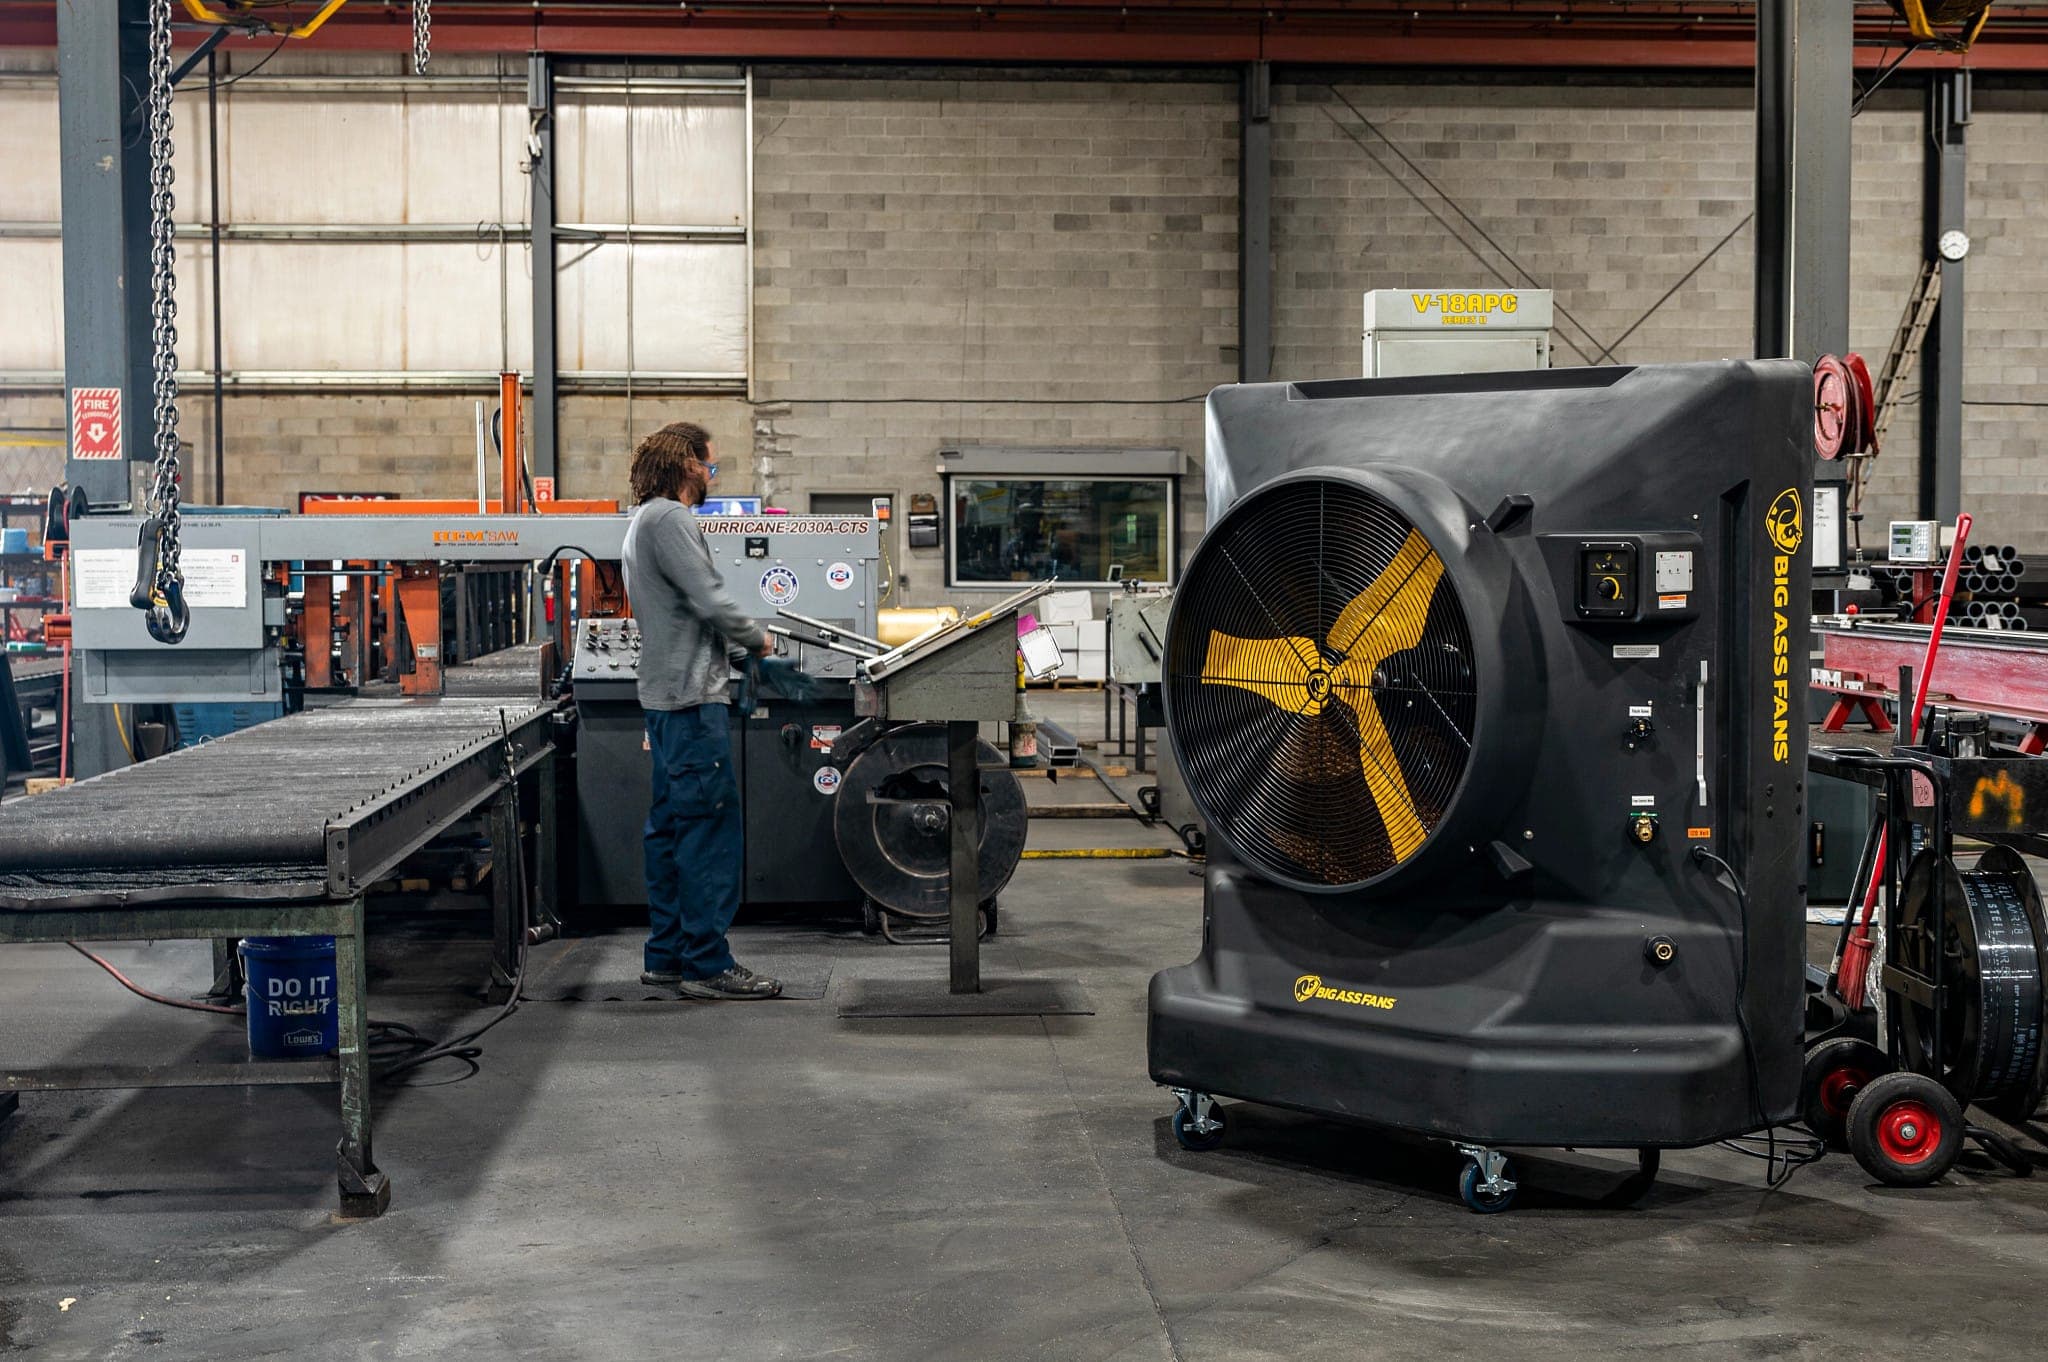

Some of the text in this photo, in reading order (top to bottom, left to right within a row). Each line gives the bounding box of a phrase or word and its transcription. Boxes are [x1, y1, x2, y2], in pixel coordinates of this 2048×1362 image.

[1411, 293, 1519, 313] V-18APC
[1441, 315, 1477, 325] SERIES
[83, 399, 110, 410] FIRE
[487, 530, 519, 542] SAW
[1773, 556, 1789, 762] BIG ASS FANS
[269, 976, 330, 997] DO IT
[269, 998, 330, 1016] RIGHT
[1316, 987, 1395, 1009] BIG ASS FANS
